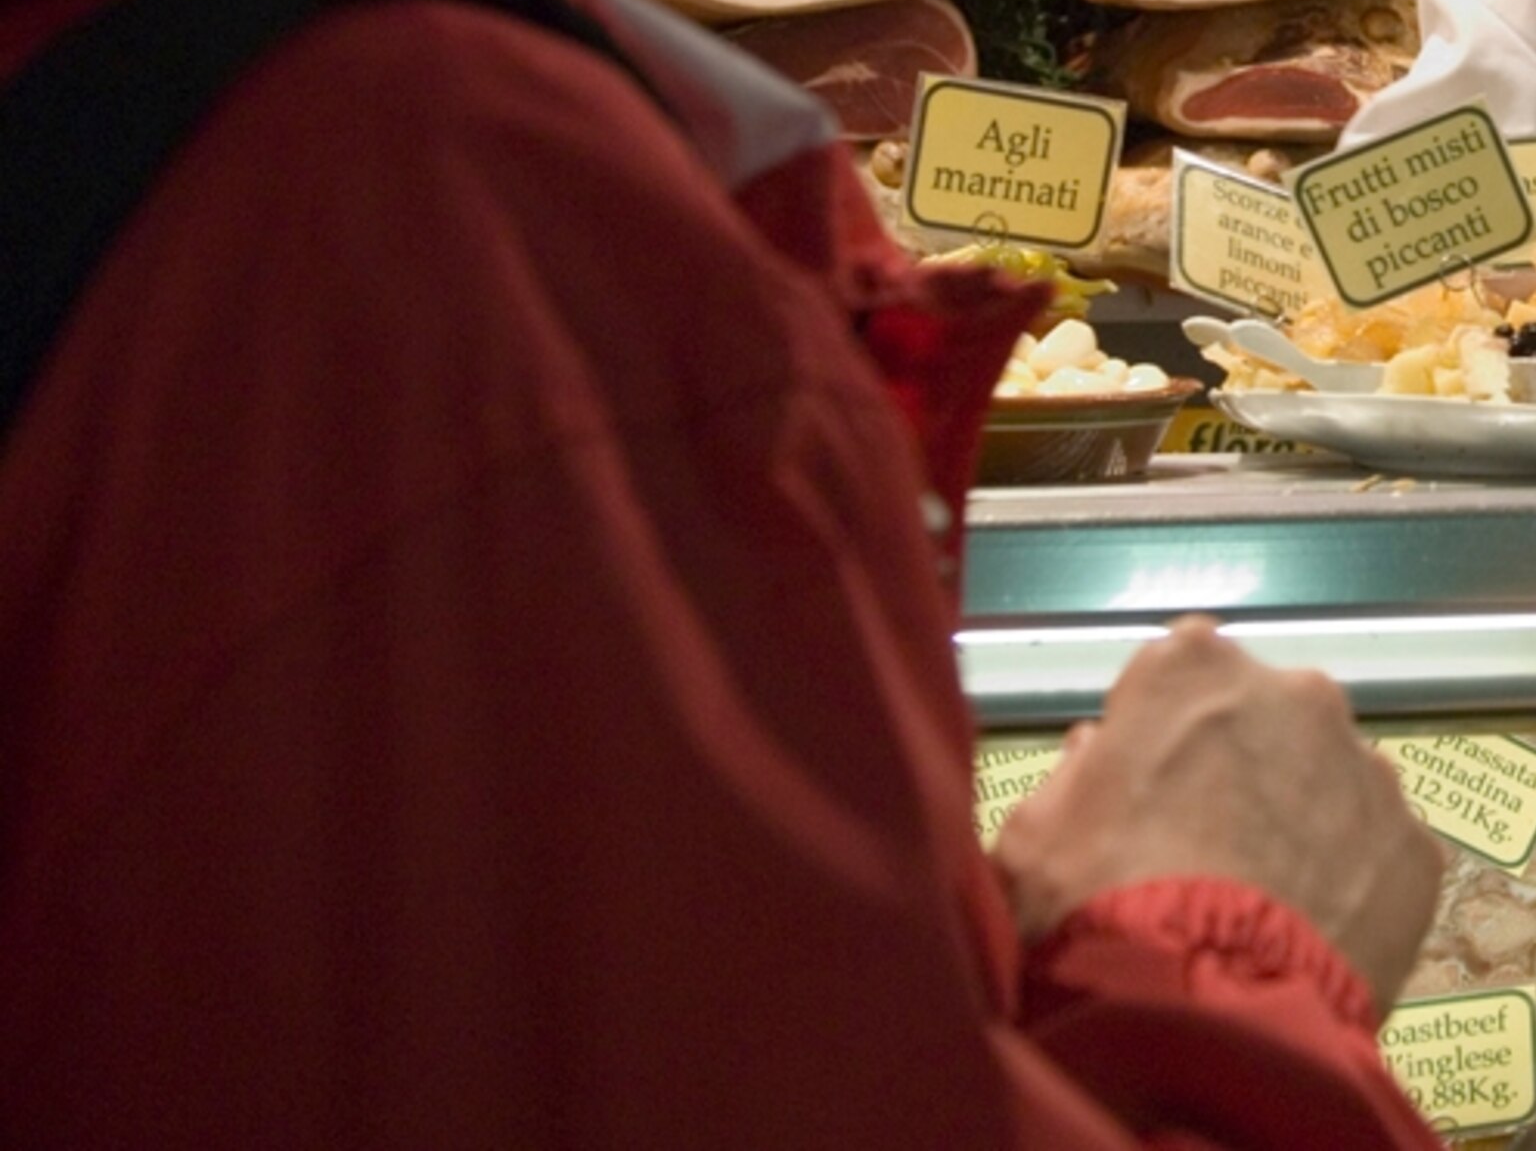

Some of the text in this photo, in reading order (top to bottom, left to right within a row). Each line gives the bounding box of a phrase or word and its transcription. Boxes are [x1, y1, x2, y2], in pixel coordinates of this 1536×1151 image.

[975, 118, 1053, 167] Agli
[931, 166, 1080, 211] marinati
[1305, 121, 1486, 216] Frutti misti
[1213, 178, 1289, 224] Scorze
[1347, 175, 1479, 243] di bosco
[1218, 212, 1295, 250] arance
[1366, 206, 1492, 289] piccanti
[1228, 236, 1302, 283] limoni
[1400, 742, 1524, 813] contadina
[1381, 1004, 1509, 1046] oastbeef
